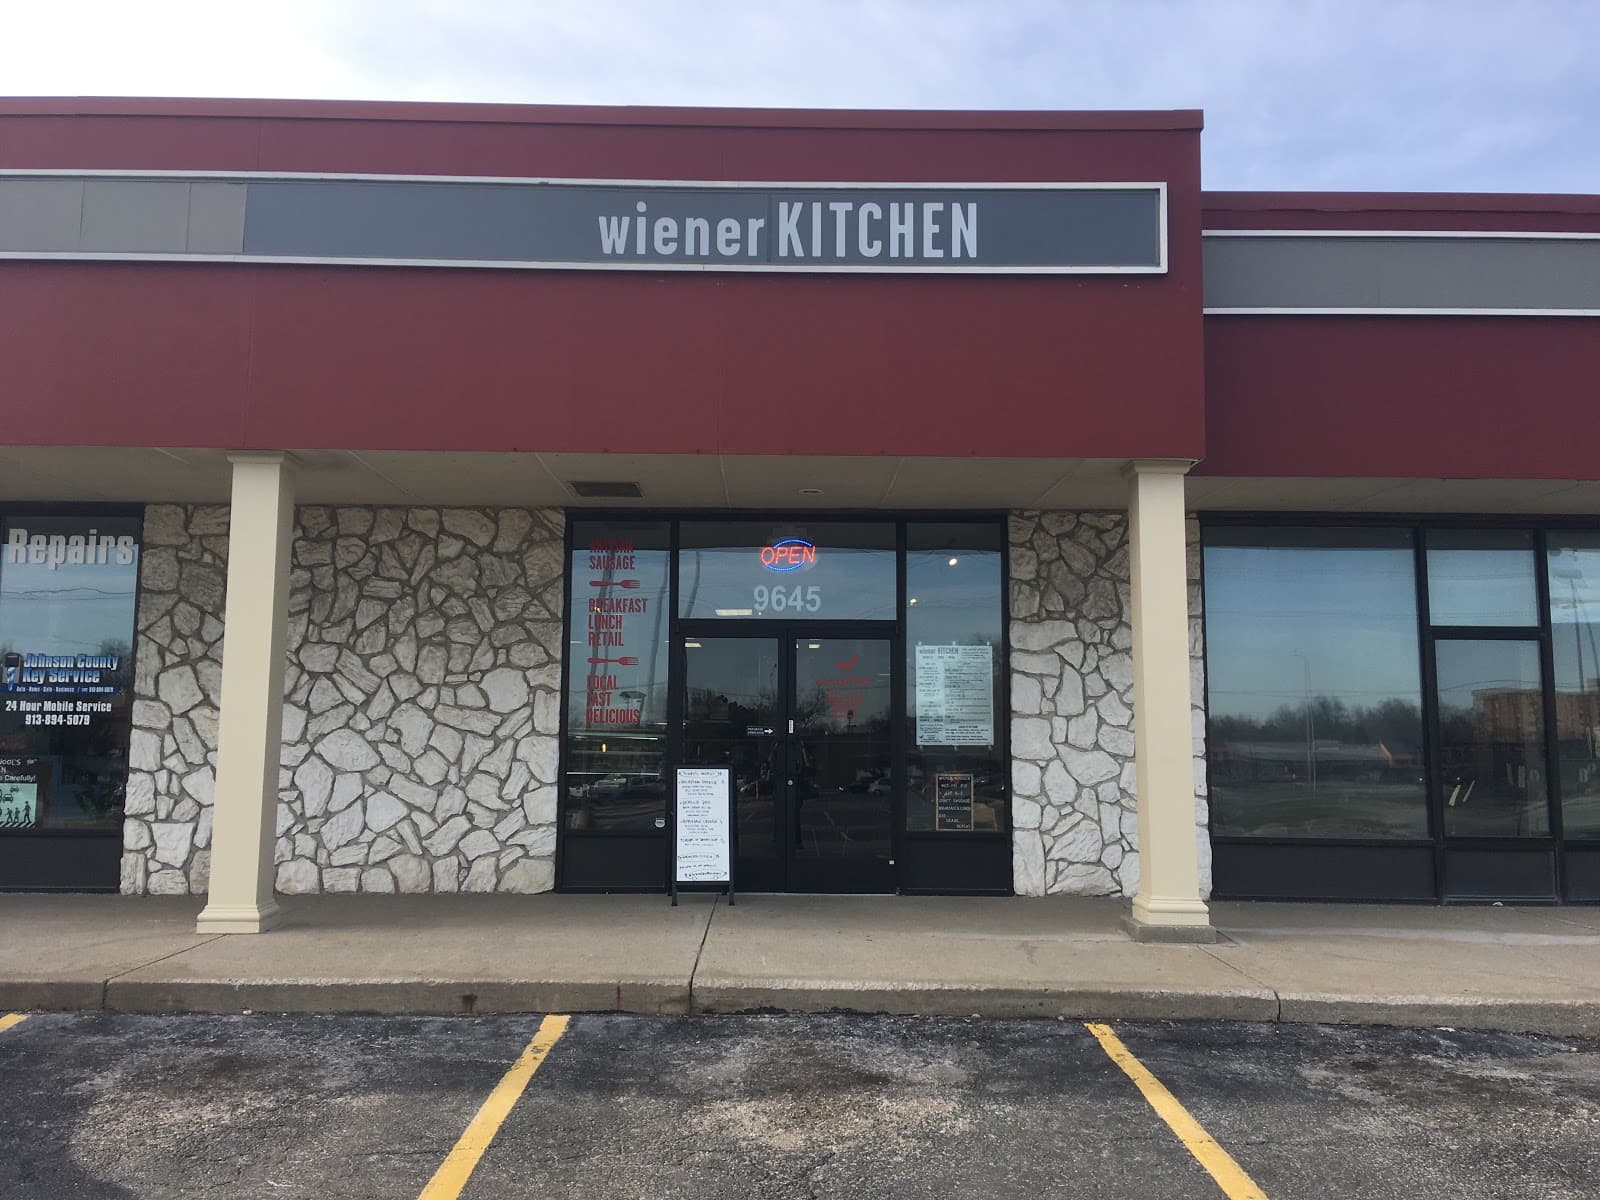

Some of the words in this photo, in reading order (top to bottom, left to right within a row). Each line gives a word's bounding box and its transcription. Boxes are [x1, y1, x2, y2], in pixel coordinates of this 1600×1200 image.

[598, 201, 765, 256] wiener
[778, 202, 978, 258] KITCHEN
[7, 528, 135, 570] Repairs
[760, 545, 817, 565] OPEN
[589, 556, 636, 570] SAUSAGE
[588, 598, 648, 613] BREAKFAST
[753, 585, 822, 612] 9645
[588, 615, 623, 629] LUNCH
[588, 631, 624, 647] RETAIL
[23, 653, 75, 668] Johnson
[76, 653, 119, 671] County
[22, 668, 46, 684] Key
[48, 668, 101, 683] Service
[587, 674, 618, 690] LOCAL
[5, 700, 17, 711] 24
[19, 700, 42, 711] Hour
[43, 700, 74, 712] Mobile
[76, 701, 112, 712] Service
[586, 709, 641, 724] DELICIOUS
